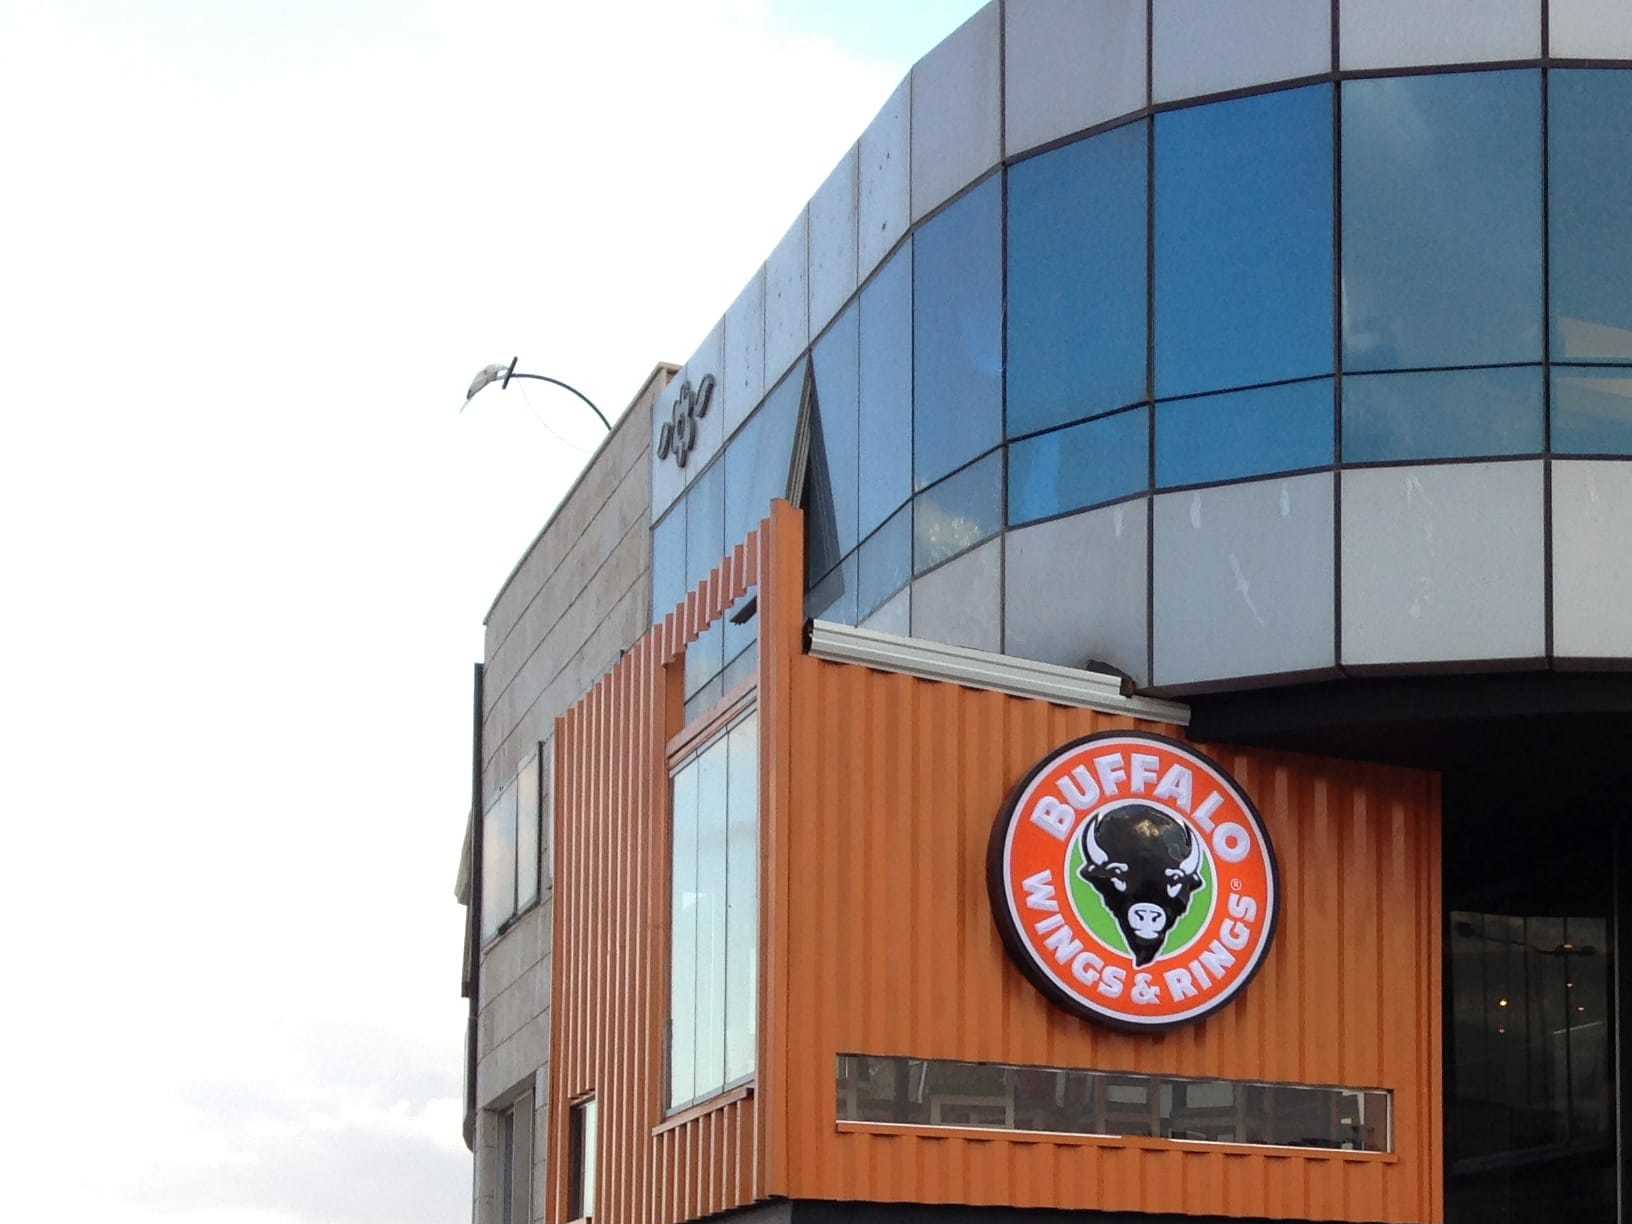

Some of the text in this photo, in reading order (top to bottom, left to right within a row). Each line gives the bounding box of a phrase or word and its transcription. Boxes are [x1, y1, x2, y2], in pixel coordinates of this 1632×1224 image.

[1030, 753, 1251, 864] BUFFALO
[1021, 868, 1258, 1005] WINGS & RINGS
